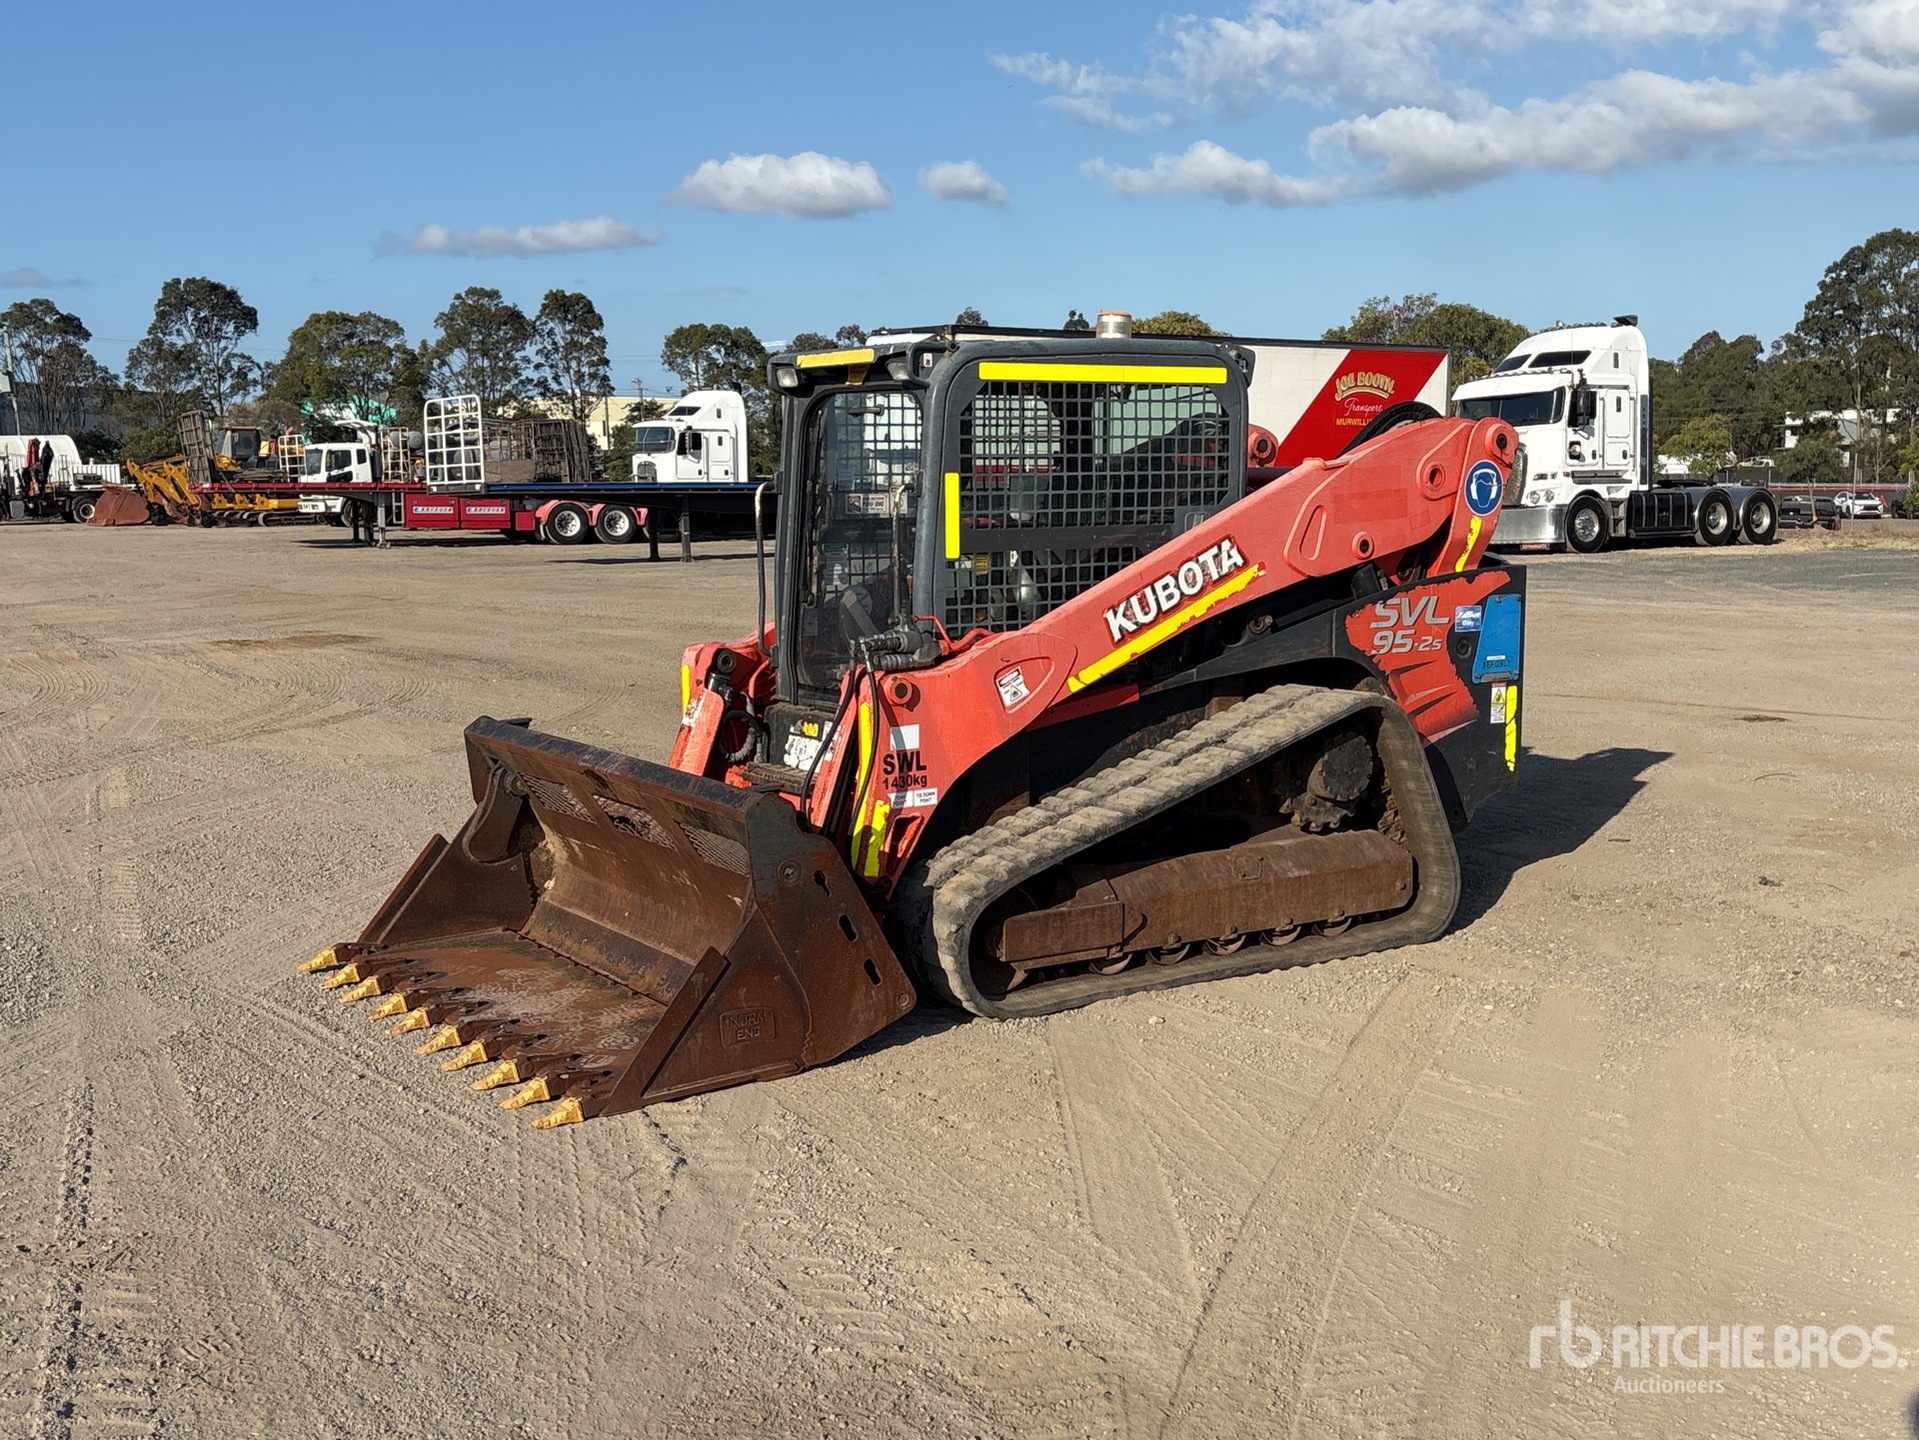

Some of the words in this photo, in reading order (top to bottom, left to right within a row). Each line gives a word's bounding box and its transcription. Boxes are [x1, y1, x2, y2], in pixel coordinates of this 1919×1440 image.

[1335, 372, 1356, 401] JOE
[1344, 397, 1384, 418] Transport
[1103, 538, 1244, 643] KUBOTA
[1370, 595, 1450, 629] SVL
[883, 751, 927, 775] SWL
[883, 774, 927, 790] 1430kg
